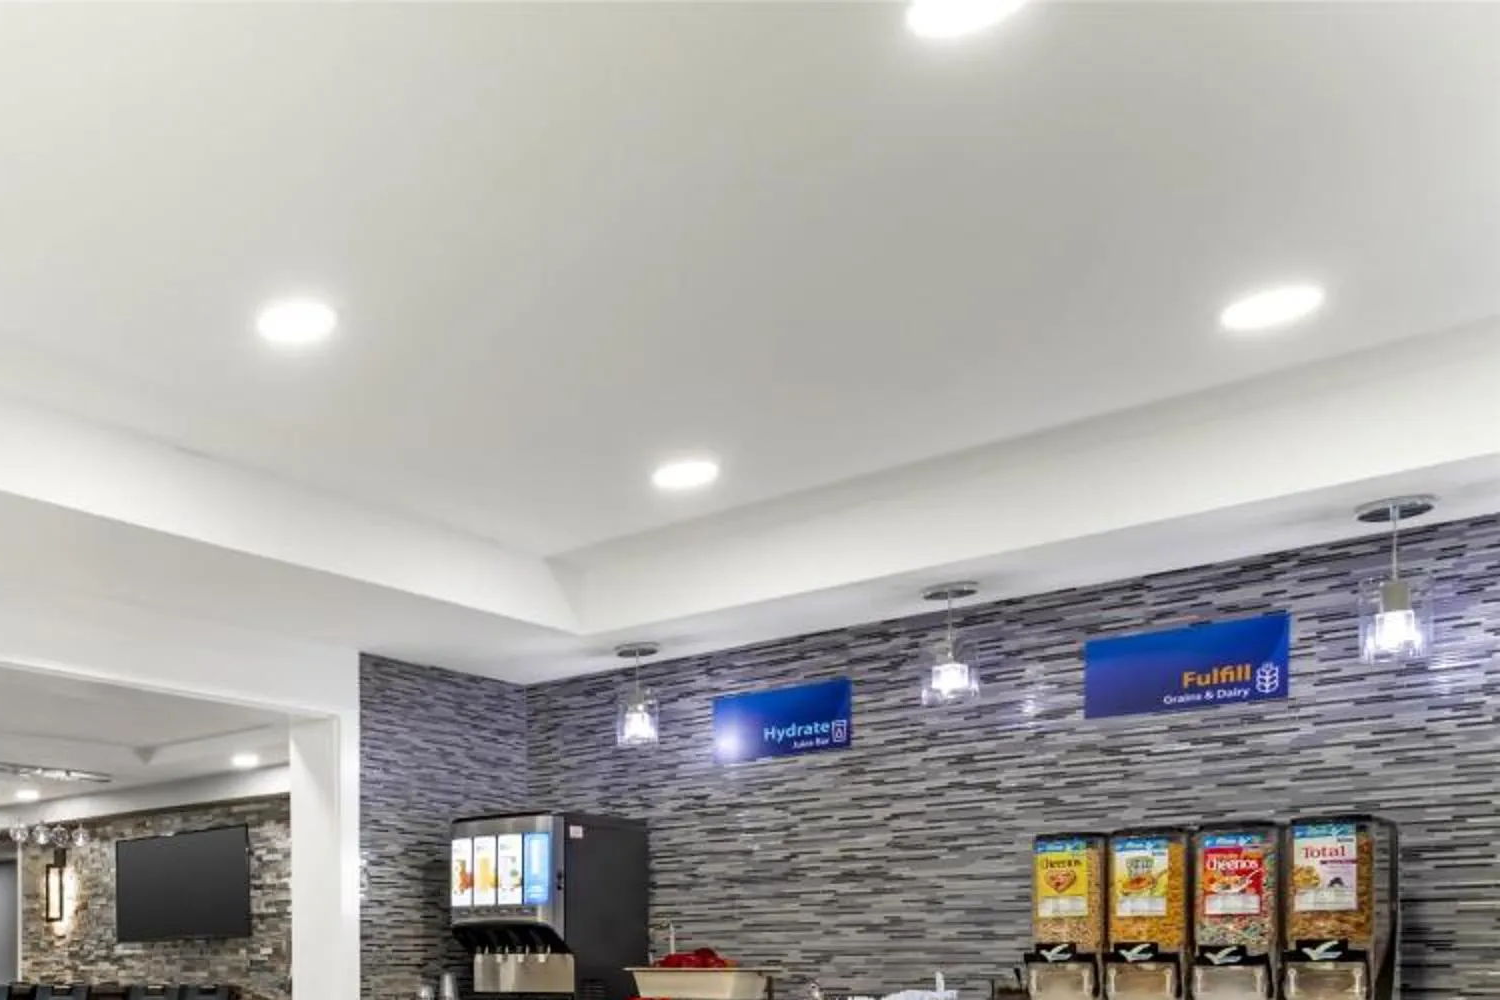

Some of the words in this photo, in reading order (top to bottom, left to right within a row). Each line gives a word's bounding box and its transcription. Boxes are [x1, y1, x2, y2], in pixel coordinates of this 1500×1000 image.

[1182, 663, 1252, 689] Fulfill
[1163, 693, 1202, 705] Grains
[1203, 690, 1214, 700] &
[1216, 687, 1251, 700] Dairy
[763, 720, 830, 745] Hydrate
[1302, 844, 1347, 859] Total
[1204, 857, 1259, 872] Cheerios
